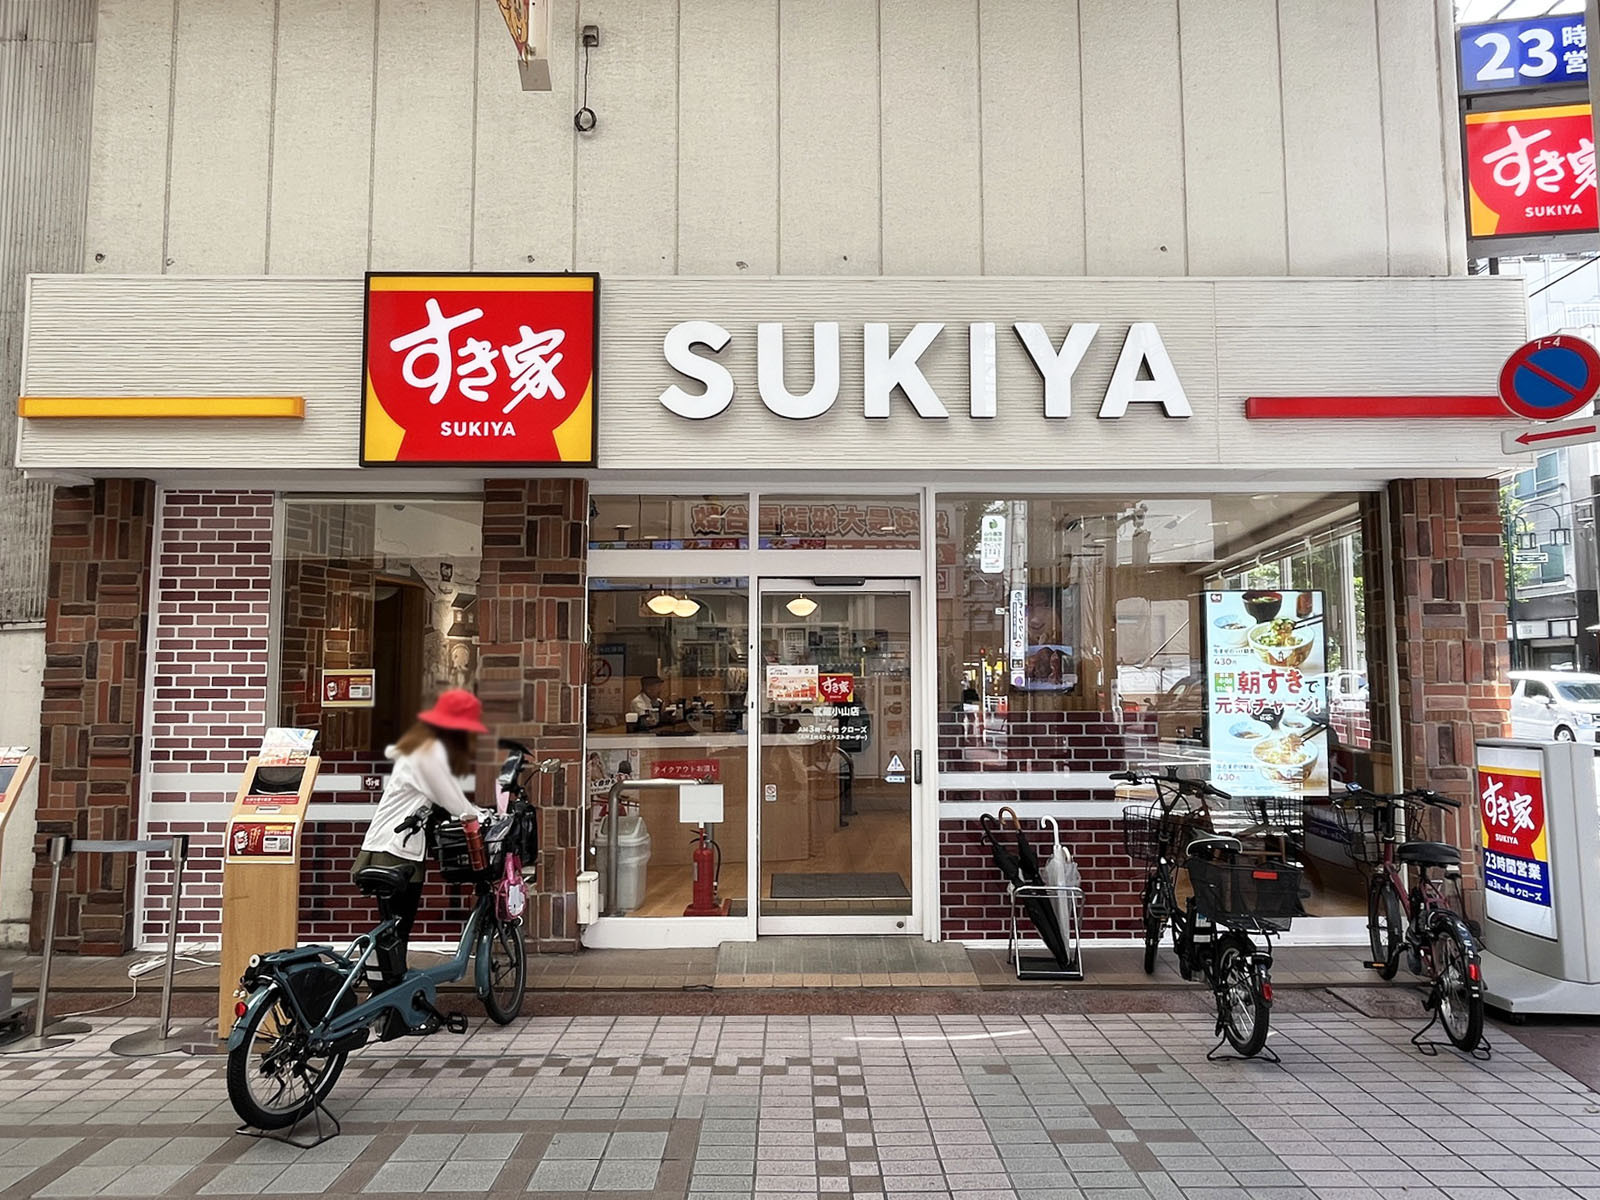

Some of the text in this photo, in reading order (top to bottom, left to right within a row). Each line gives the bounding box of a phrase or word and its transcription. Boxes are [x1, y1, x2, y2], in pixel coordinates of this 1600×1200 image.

[1474, 28, 1558, 81] 23
[1525, 204, 1583, 218] SUKIYA
[1534, 336, 1561, 350] 7-4
[389, 297, 567, 415] すき家
[658, 320, 1195, 420] SUKIYA
[440, 421, 517, 437] SUKIYA
[821, 676, 850, 695] すき家
[1237, 668, 1320, 694] 朝すきで
[1215, 697, 1321, 714] 元気チャージ!
[841, 726, 868, 734] クローズ
[1482, 776, 1535, 834] すき家
[1494, 833, 1519, 846] SUKIYA
[1485, 852, 1542, 881] 23時間営業
[1516, 888, 1542, 902] クローズ
